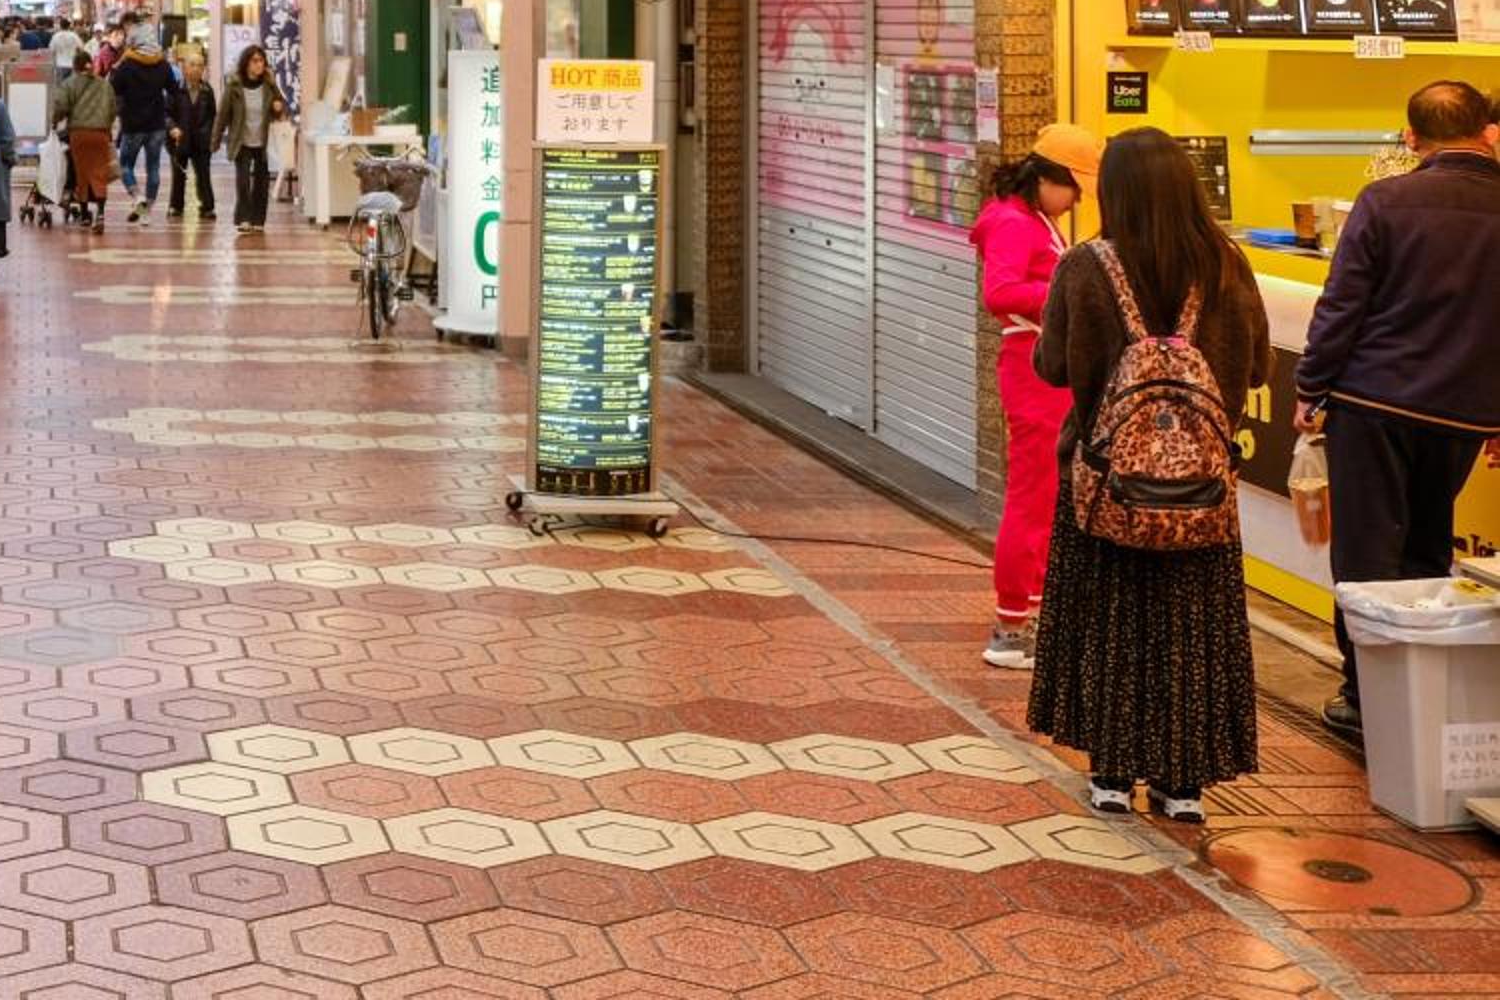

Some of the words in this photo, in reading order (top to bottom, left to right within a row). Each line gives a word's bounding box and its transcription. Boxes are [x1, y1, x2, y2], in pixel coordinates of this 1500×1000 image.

[551, 67, 597, 86] HOT
[603, 68, 641, 87] 商品
[1114, 85, 1141, 96] Uber
[556, 93, 637, 111] ご用意して
[1114, 95, 1141, 107] Eats
[563, 116, 629, 132] おります
